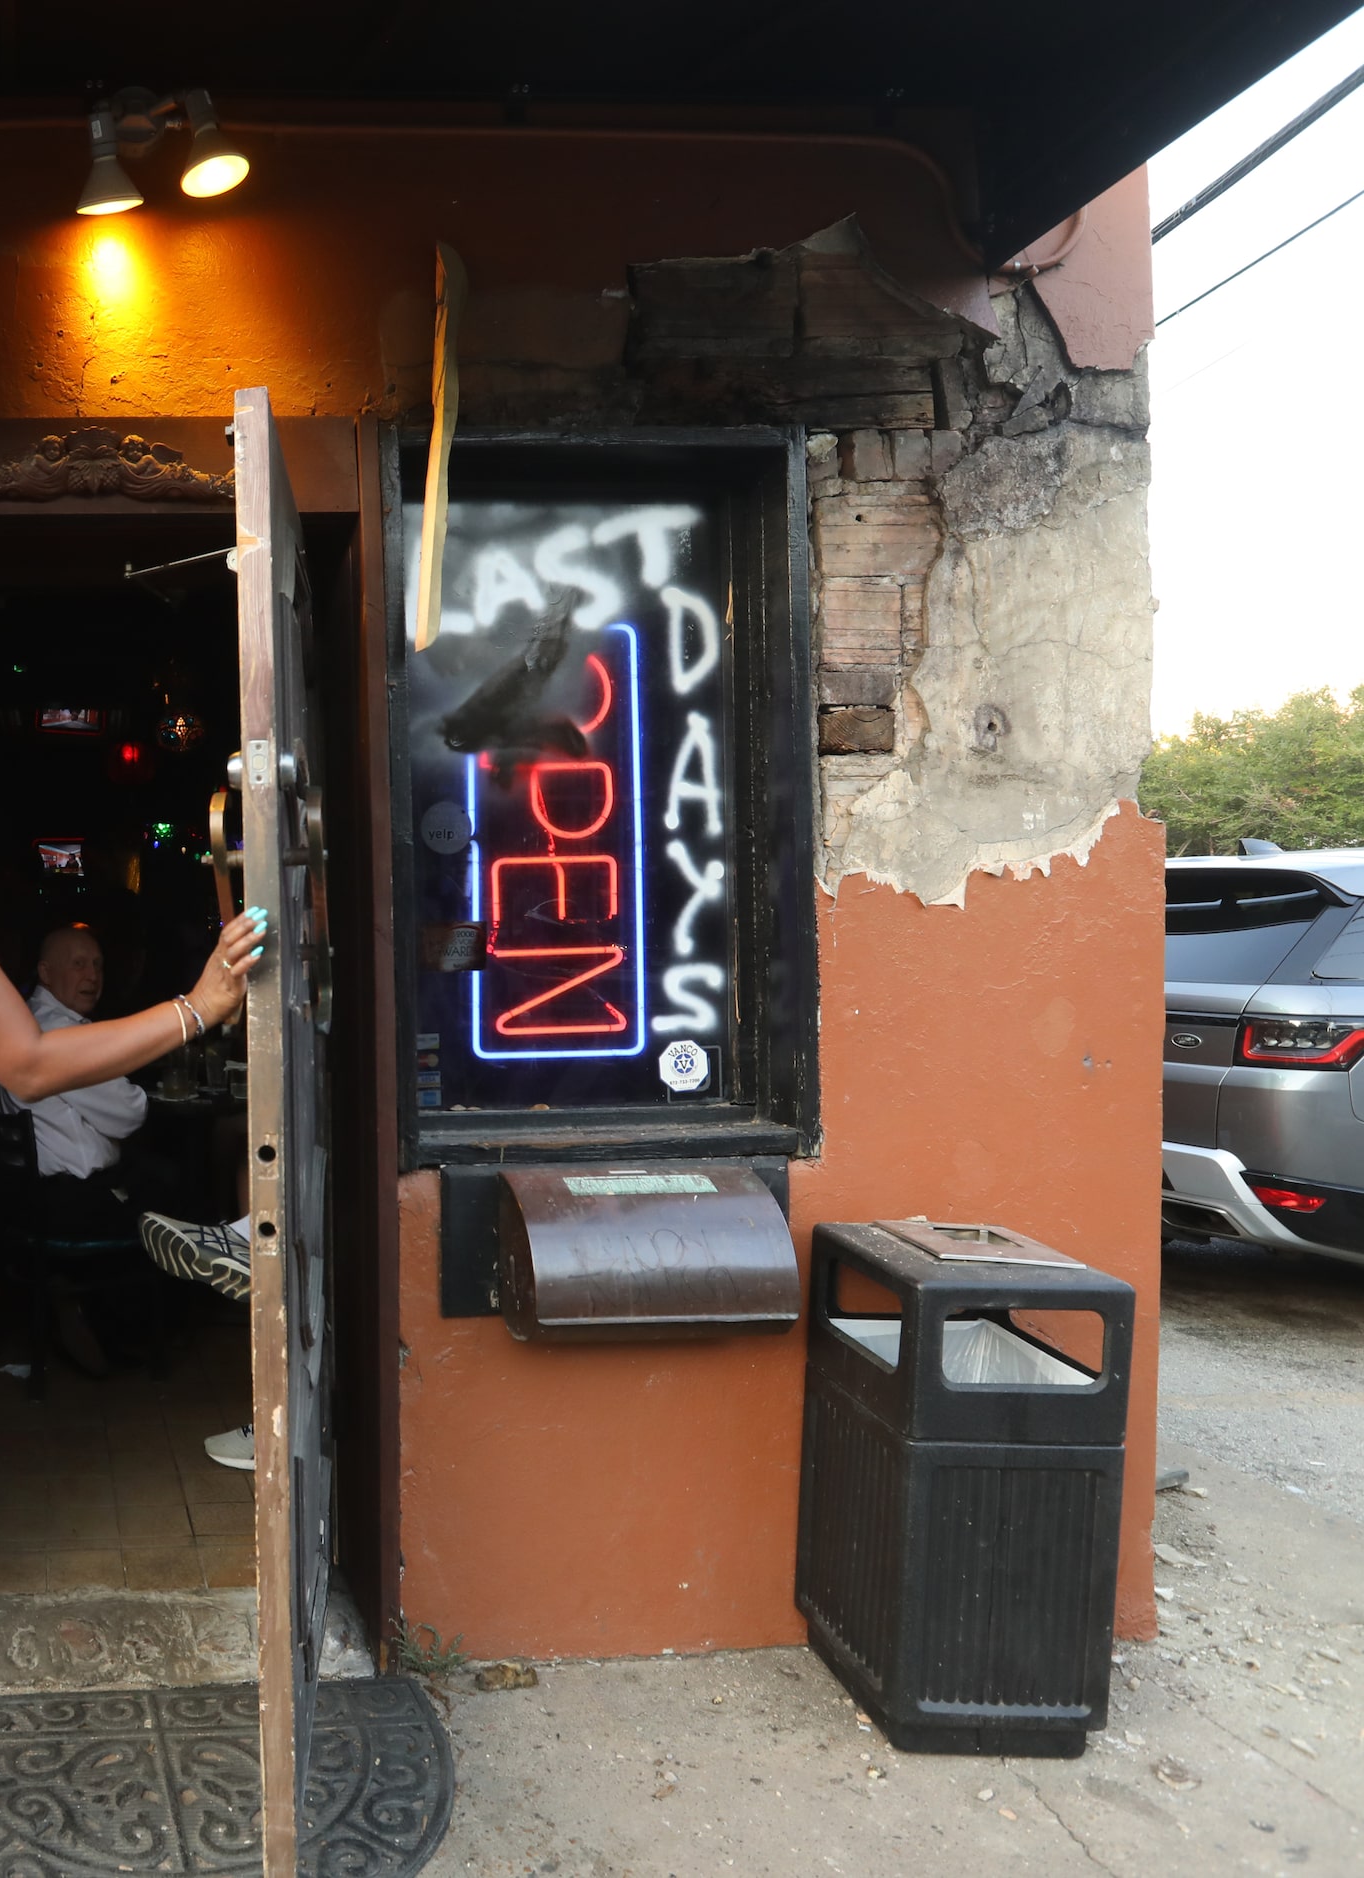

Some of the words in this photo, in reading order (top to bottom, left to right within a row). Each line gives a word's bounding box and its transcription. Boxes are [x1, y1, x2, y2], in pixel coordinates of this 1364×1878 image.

[407, 504, 704, 641] LAST
[651, 585, 726, 1033] DAYS
[428, 828, 455, 840] yelp
[668, 1044, 698, 1058] VANCO
[679, 1060, 689, 1070] V
